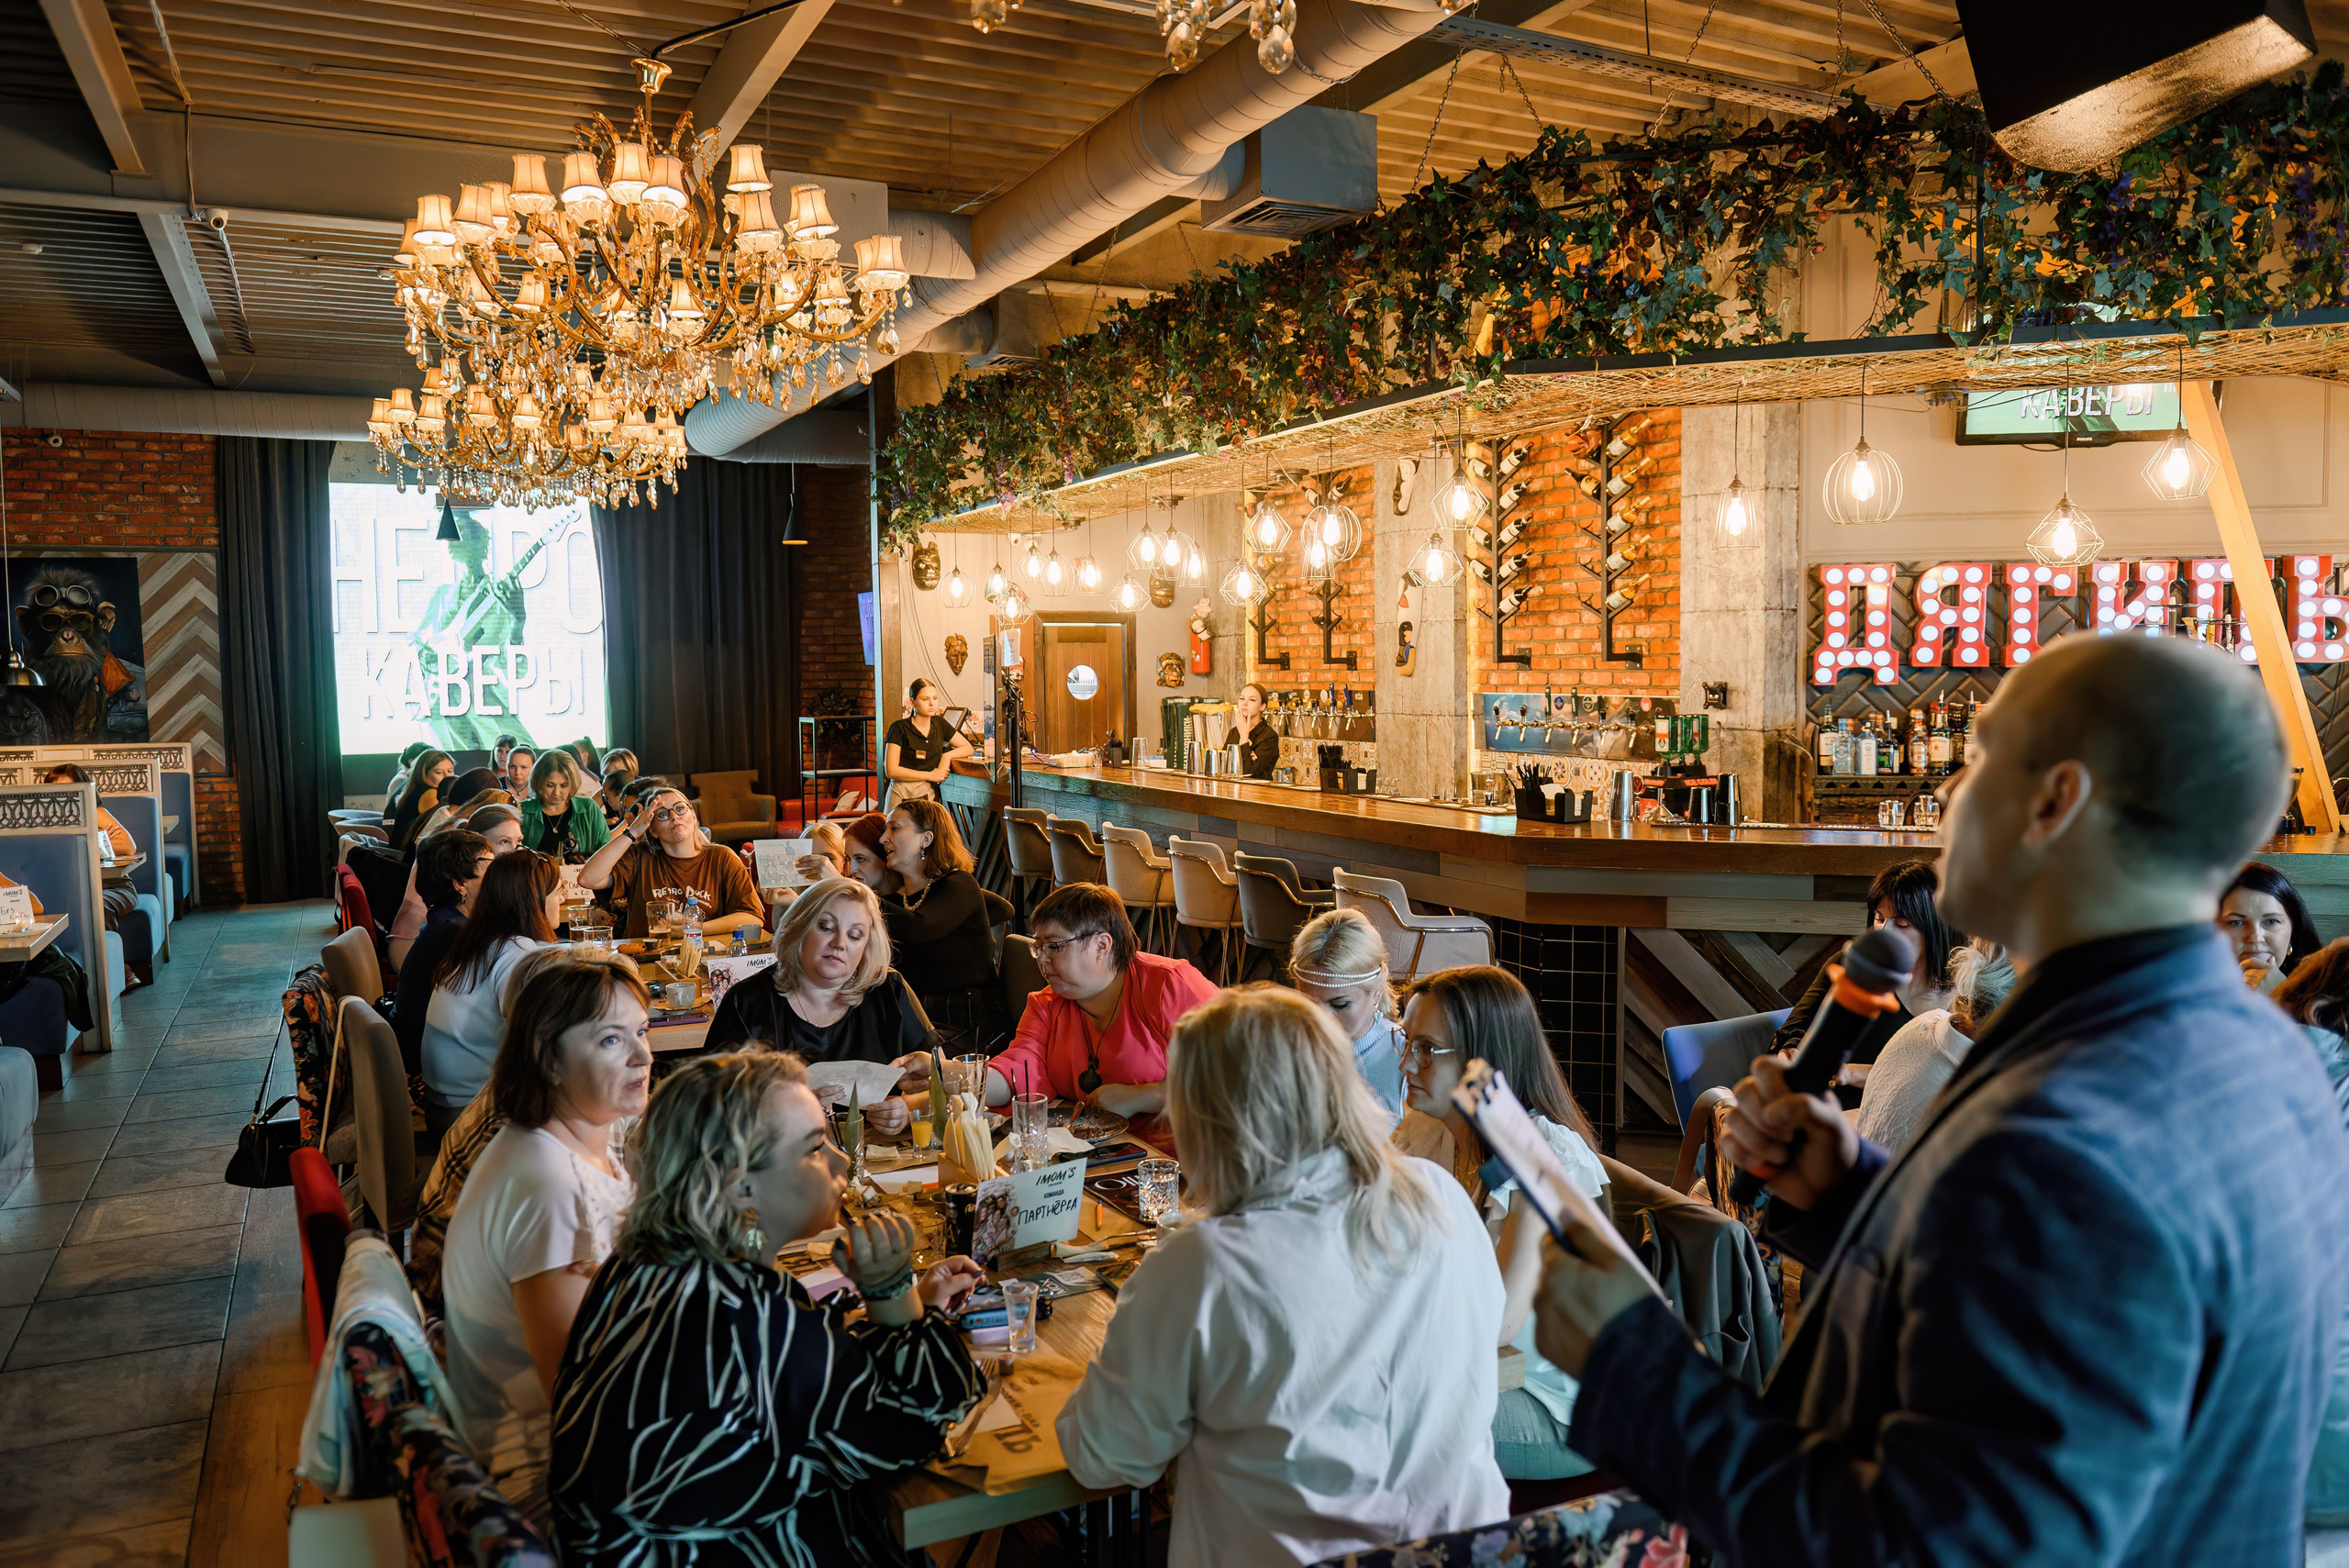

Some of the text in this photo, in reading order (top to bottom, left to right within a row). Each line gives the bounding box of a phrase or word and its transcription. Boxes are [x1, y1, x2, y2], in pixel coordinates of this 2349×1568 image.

[364, 644, 585, 719] КАВЕРЫ
[652, 886, 684, 898] RETRO
[1035, 1166, 1076, 1186] IMOM'S
